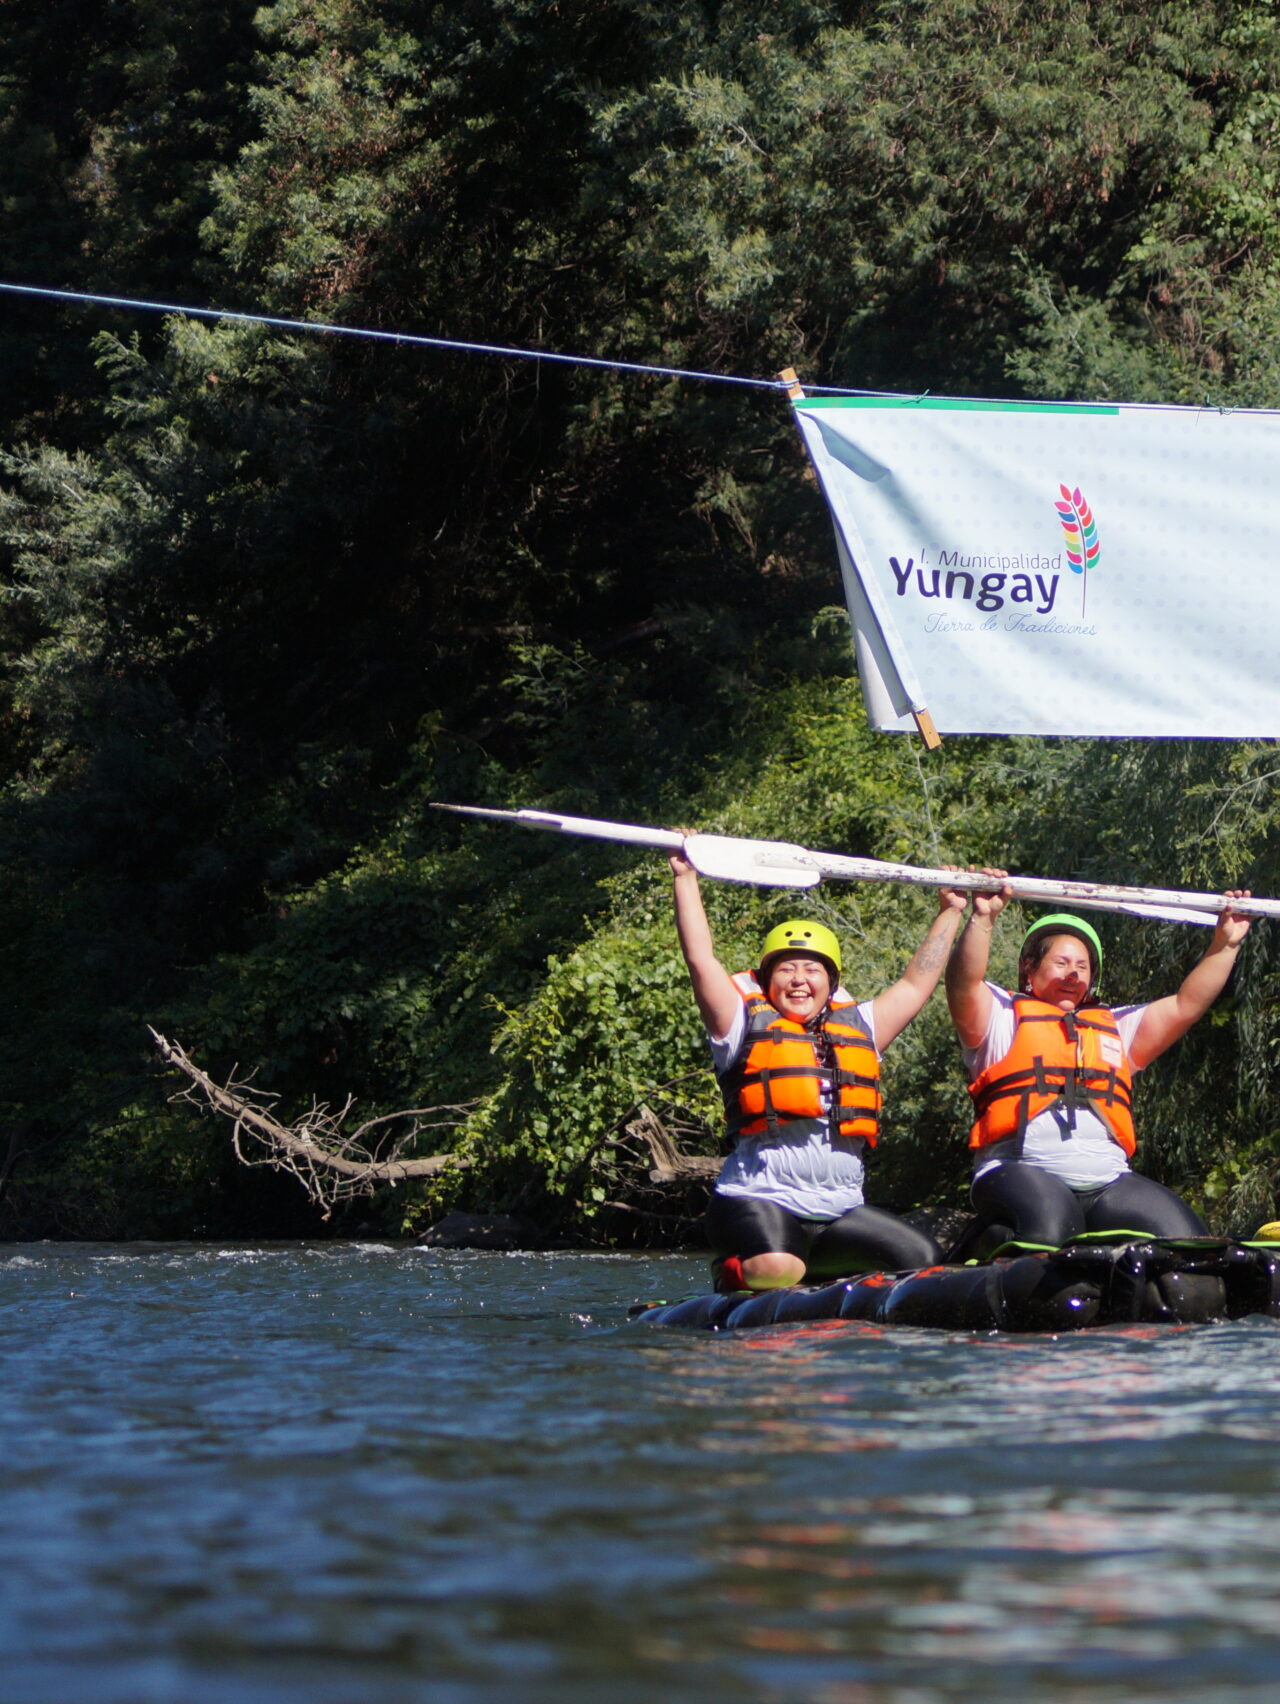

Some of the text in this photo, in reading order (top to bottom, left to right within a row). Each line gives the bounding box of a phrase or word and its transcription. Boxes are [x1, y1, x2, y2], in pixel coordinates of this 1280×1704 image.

[939, 551, 1062, 571] Municipalidad
[888, 556, 1060, 614] Yungay
[923, 612, 1097, 636] Tierra de Tradiciones
